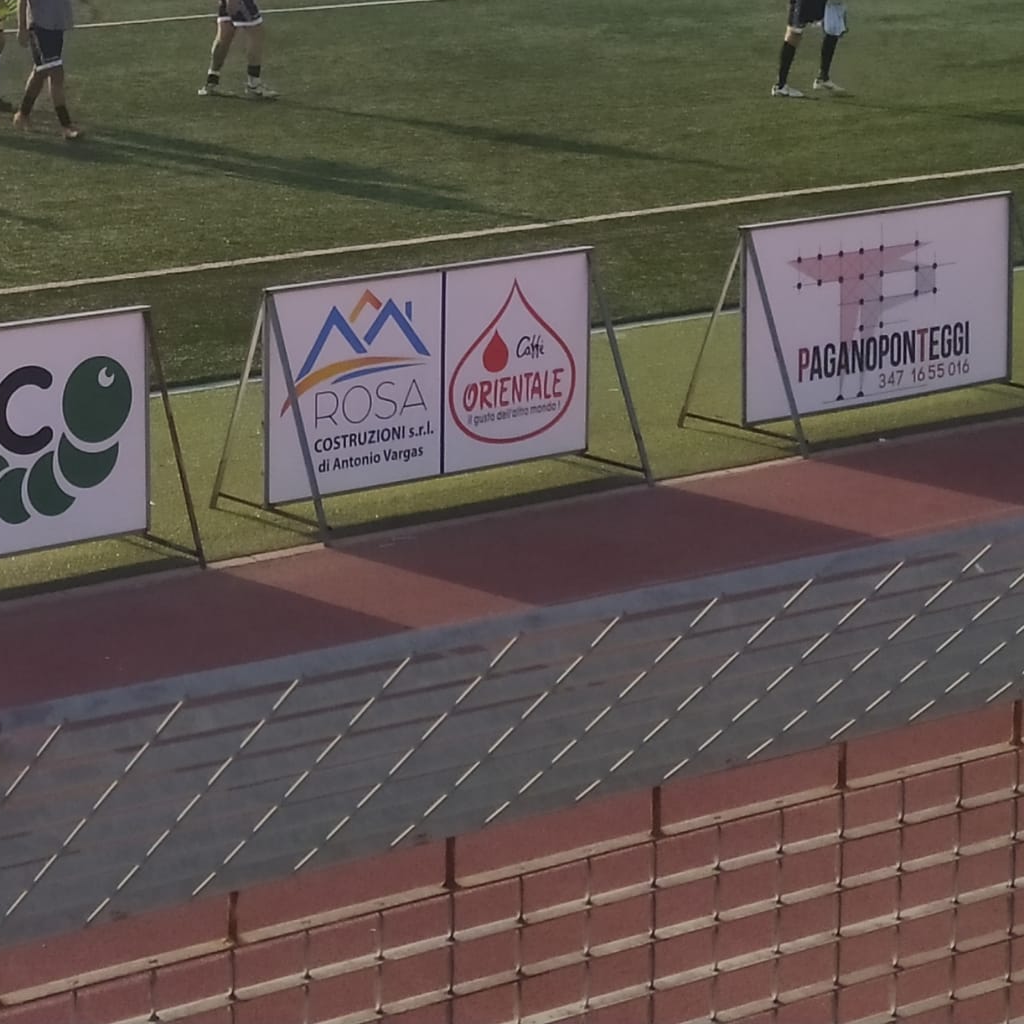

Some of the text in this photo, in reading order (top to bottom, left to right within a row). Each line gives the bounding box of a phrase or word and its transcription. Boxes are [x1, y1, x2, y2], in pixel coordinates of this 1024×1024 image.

[797, 320, 970, 383] PAGANOPONTEGGI
[462, 368, 565, 412] ORIENTALE
[878, 370, 904, 389] 347
[314, 378, 428, 429] ROSA
[314, 420, 435, 453] COSTRUZIONI s.r.l.
[318, 446, 424, 473] di Antonio Vargas
